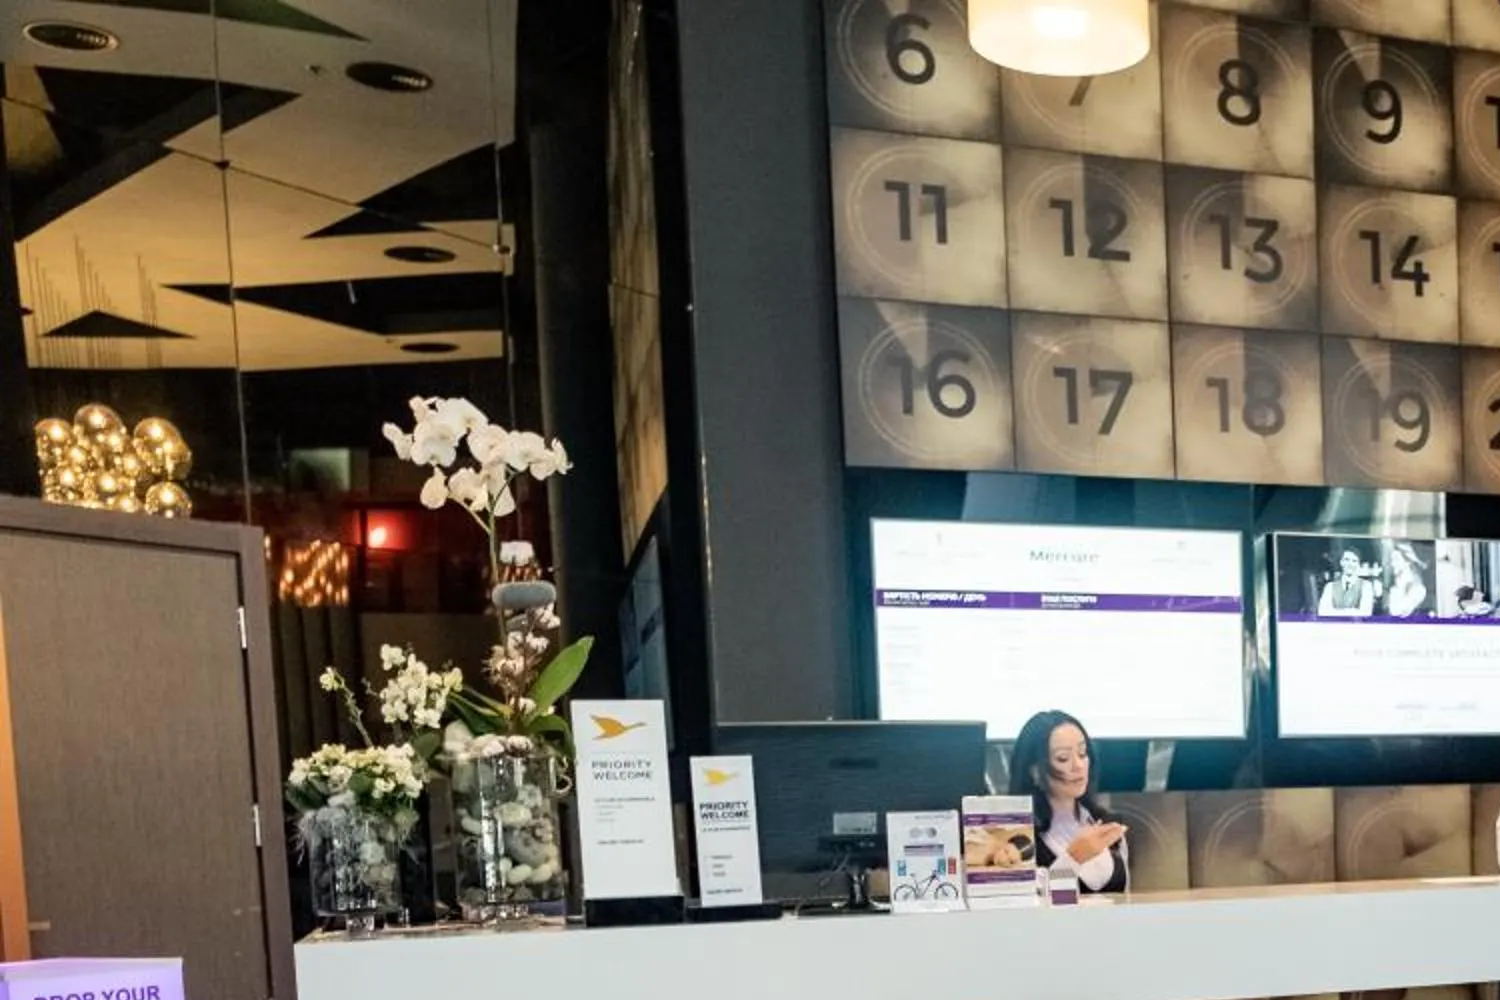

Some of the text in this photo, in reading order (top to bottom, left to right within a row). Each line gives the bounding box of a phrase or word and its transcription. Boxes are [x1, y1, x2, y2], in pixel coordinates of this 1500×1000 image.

[885, 13, 936, 85] 6
[1216, 58, 1261, 126] 8
[1361, 80, 1403, 144] 9
[884, 181, 948, 245] 11
[1050, 198, 1131, 263] 12
[1209, 213, 1283, 283] 13
[1359, 230, 1430, 297] 14
[891, 350, 977, 420] 16
[1054, 367, 1133, 436] 17
[1206, 368, 1286, 437] 18
[1365, 382, 1431, 453] 19
[591, 760, 652, 769] PRIORITY
[593, 769, 653, 781] WELCOME
[699, 801, 749, 811] PRIORITY
[700, 810, 750, 820] WELCOME
